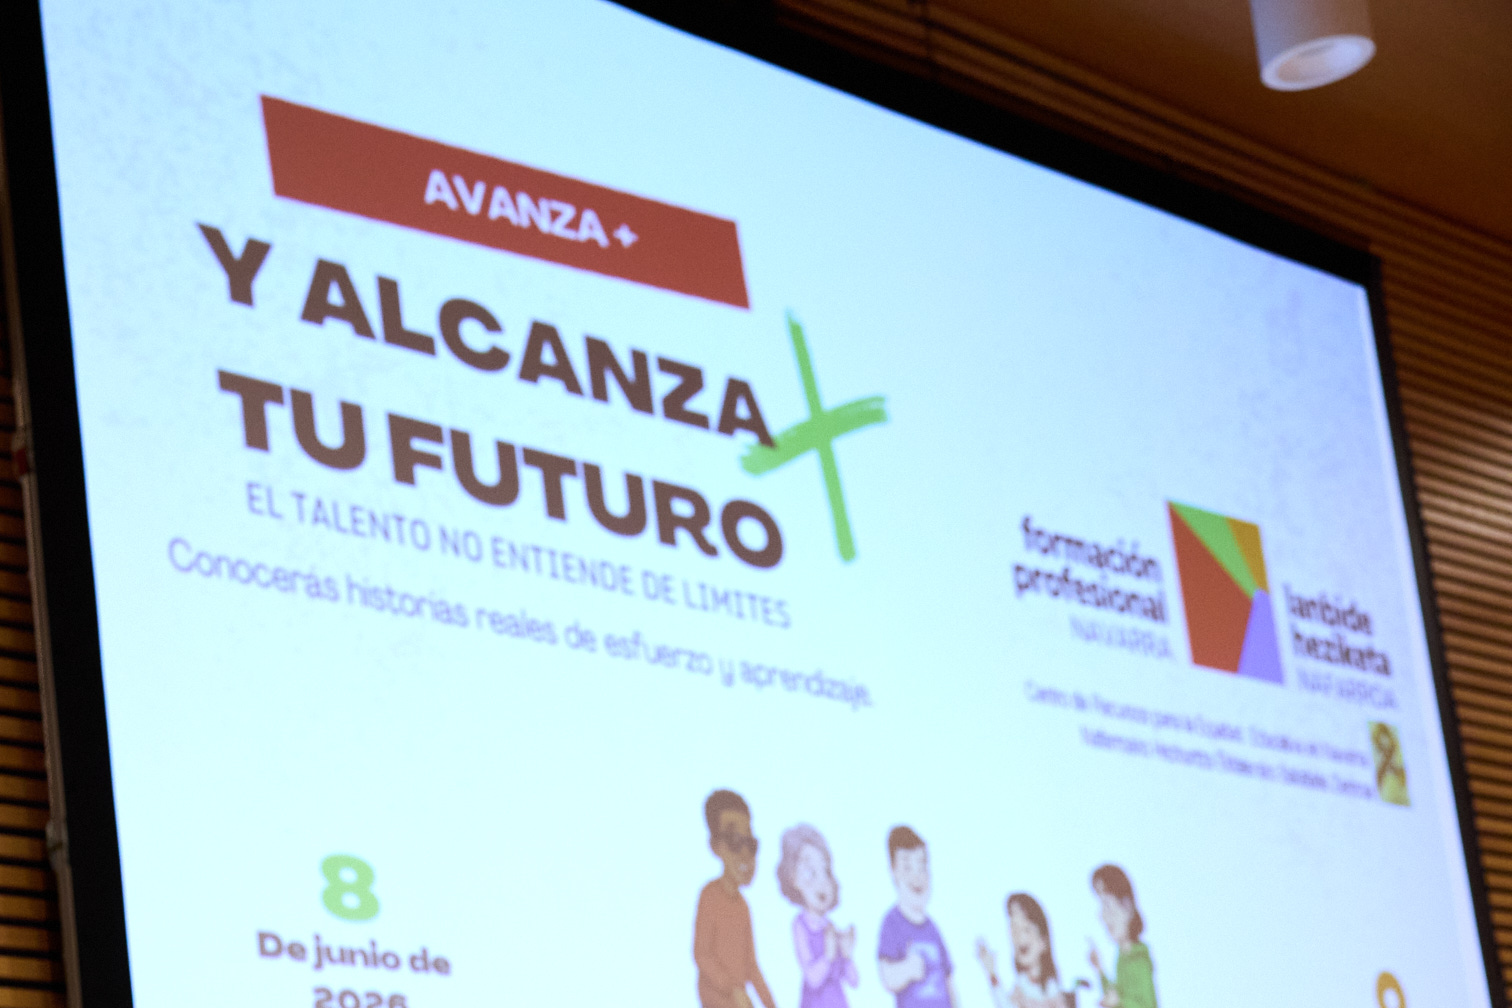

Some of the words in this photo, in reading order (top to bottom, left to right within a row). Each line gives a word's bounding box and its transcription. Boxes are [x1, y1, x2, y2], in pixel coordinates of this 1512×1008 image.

[196, 222, 271, 307] Y
[300, 258, 778, 450] ALCANZA
[217, 368, 366, 471] TU
[387, 412, 784, 568] FUTURO
[247, 481, 283, 520] EL
[290, 491, 431, 551] TALENTO
[438, 524, 483, 563] NO
[491, 535, 634, 596] ENTIENDE
[641, 570, 676, 605] DE
[1020, 515, 1161, 582] formación
[168, 537, 340, 602] Conocerás
[345, 574, 469, 628] historias
[476, 607, 558, 645] reales
[564, 620, 596, 652] de
[603, 630, 713, 676] esfuerzo
[719, 658, 735, 688] y
[1012, 563, 1168, 624] profesional
[320, 853, 380, 921] 8
[257, 931, 307, 961] De
[313, 934, 401, 971] junio
[408, 947, 452, 976] de
